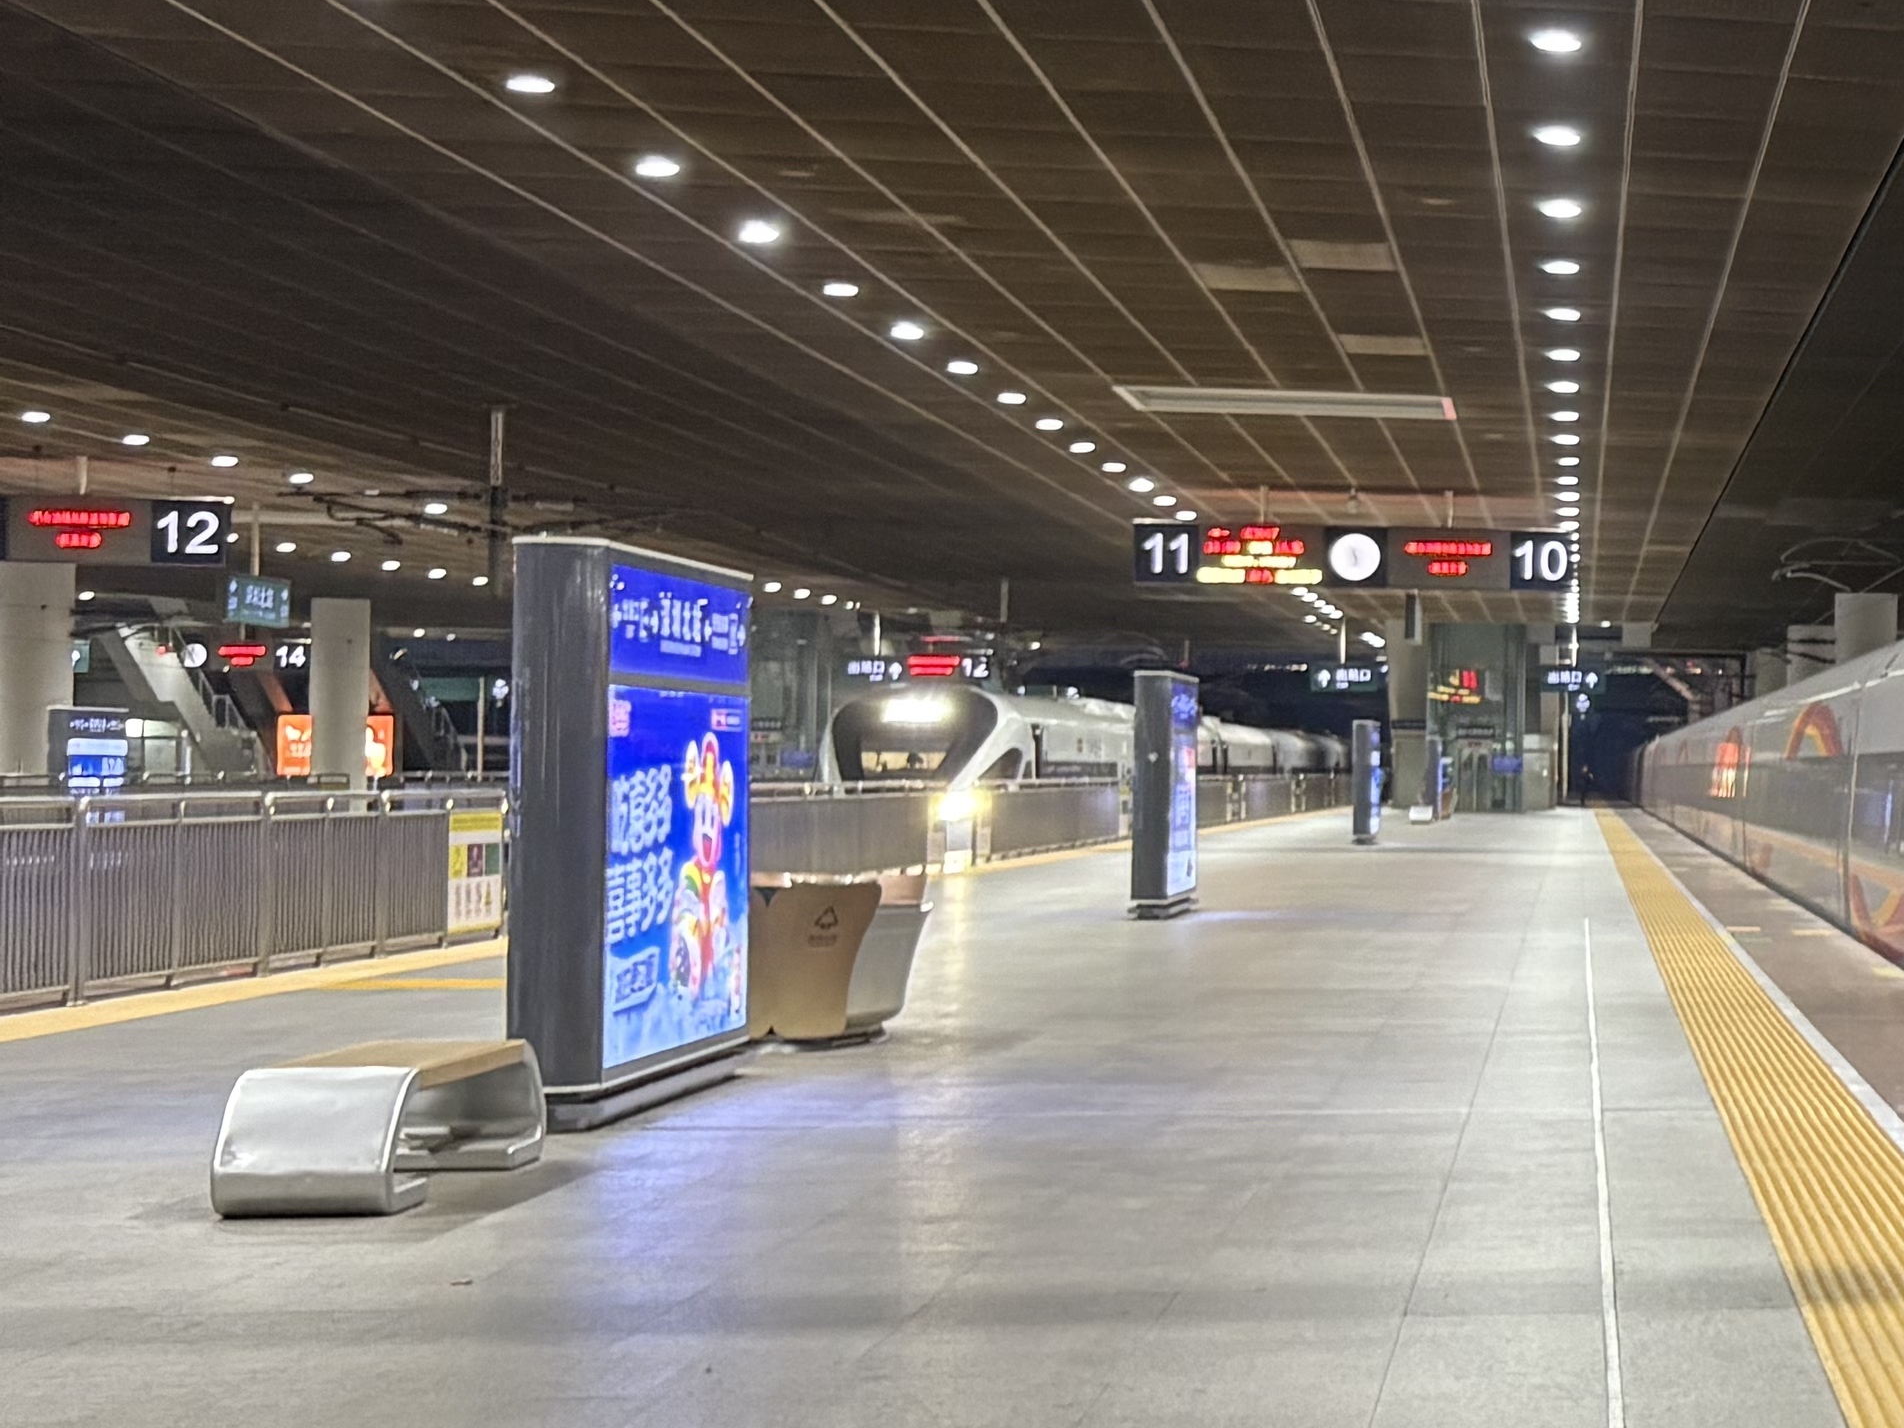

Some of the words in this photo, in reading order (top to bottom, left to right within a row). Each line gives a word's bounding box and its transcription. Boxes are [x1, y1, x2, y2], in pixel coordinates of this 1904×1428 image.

[157, 510, 220, 554] 12
[1141, 531, 1190, 574] 11
[1513, 539, 1569, 582] 10
[275, 645, 307, 669] 14
[961, 656, 990, 678] 12
